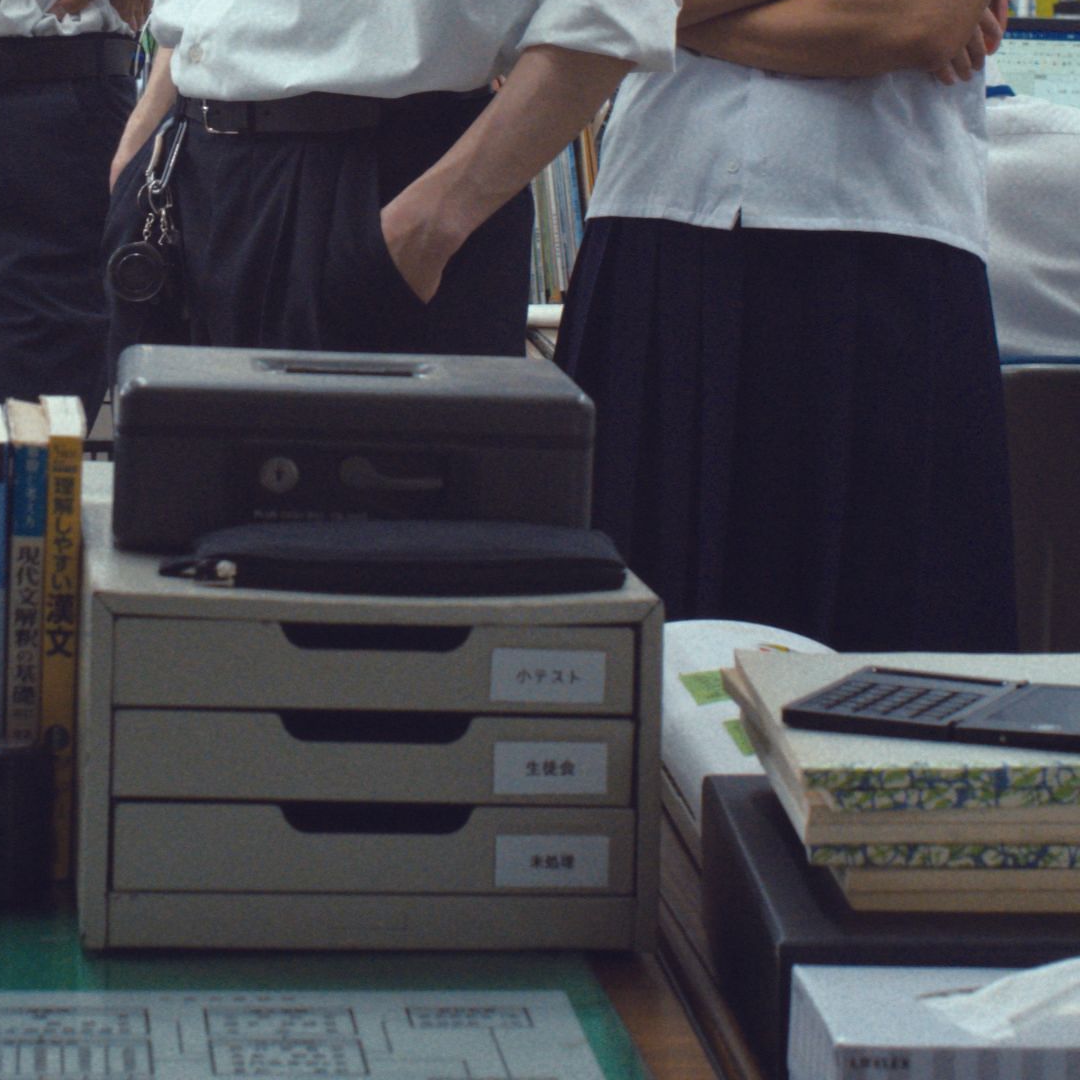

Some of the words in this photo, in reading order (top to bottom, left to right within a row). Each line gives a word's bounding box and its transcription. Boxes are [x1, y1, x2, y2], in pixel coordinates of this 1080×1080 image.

[516, 669, 580, 684] 小テスト
[526, 760, 575, 776] 生徒会
